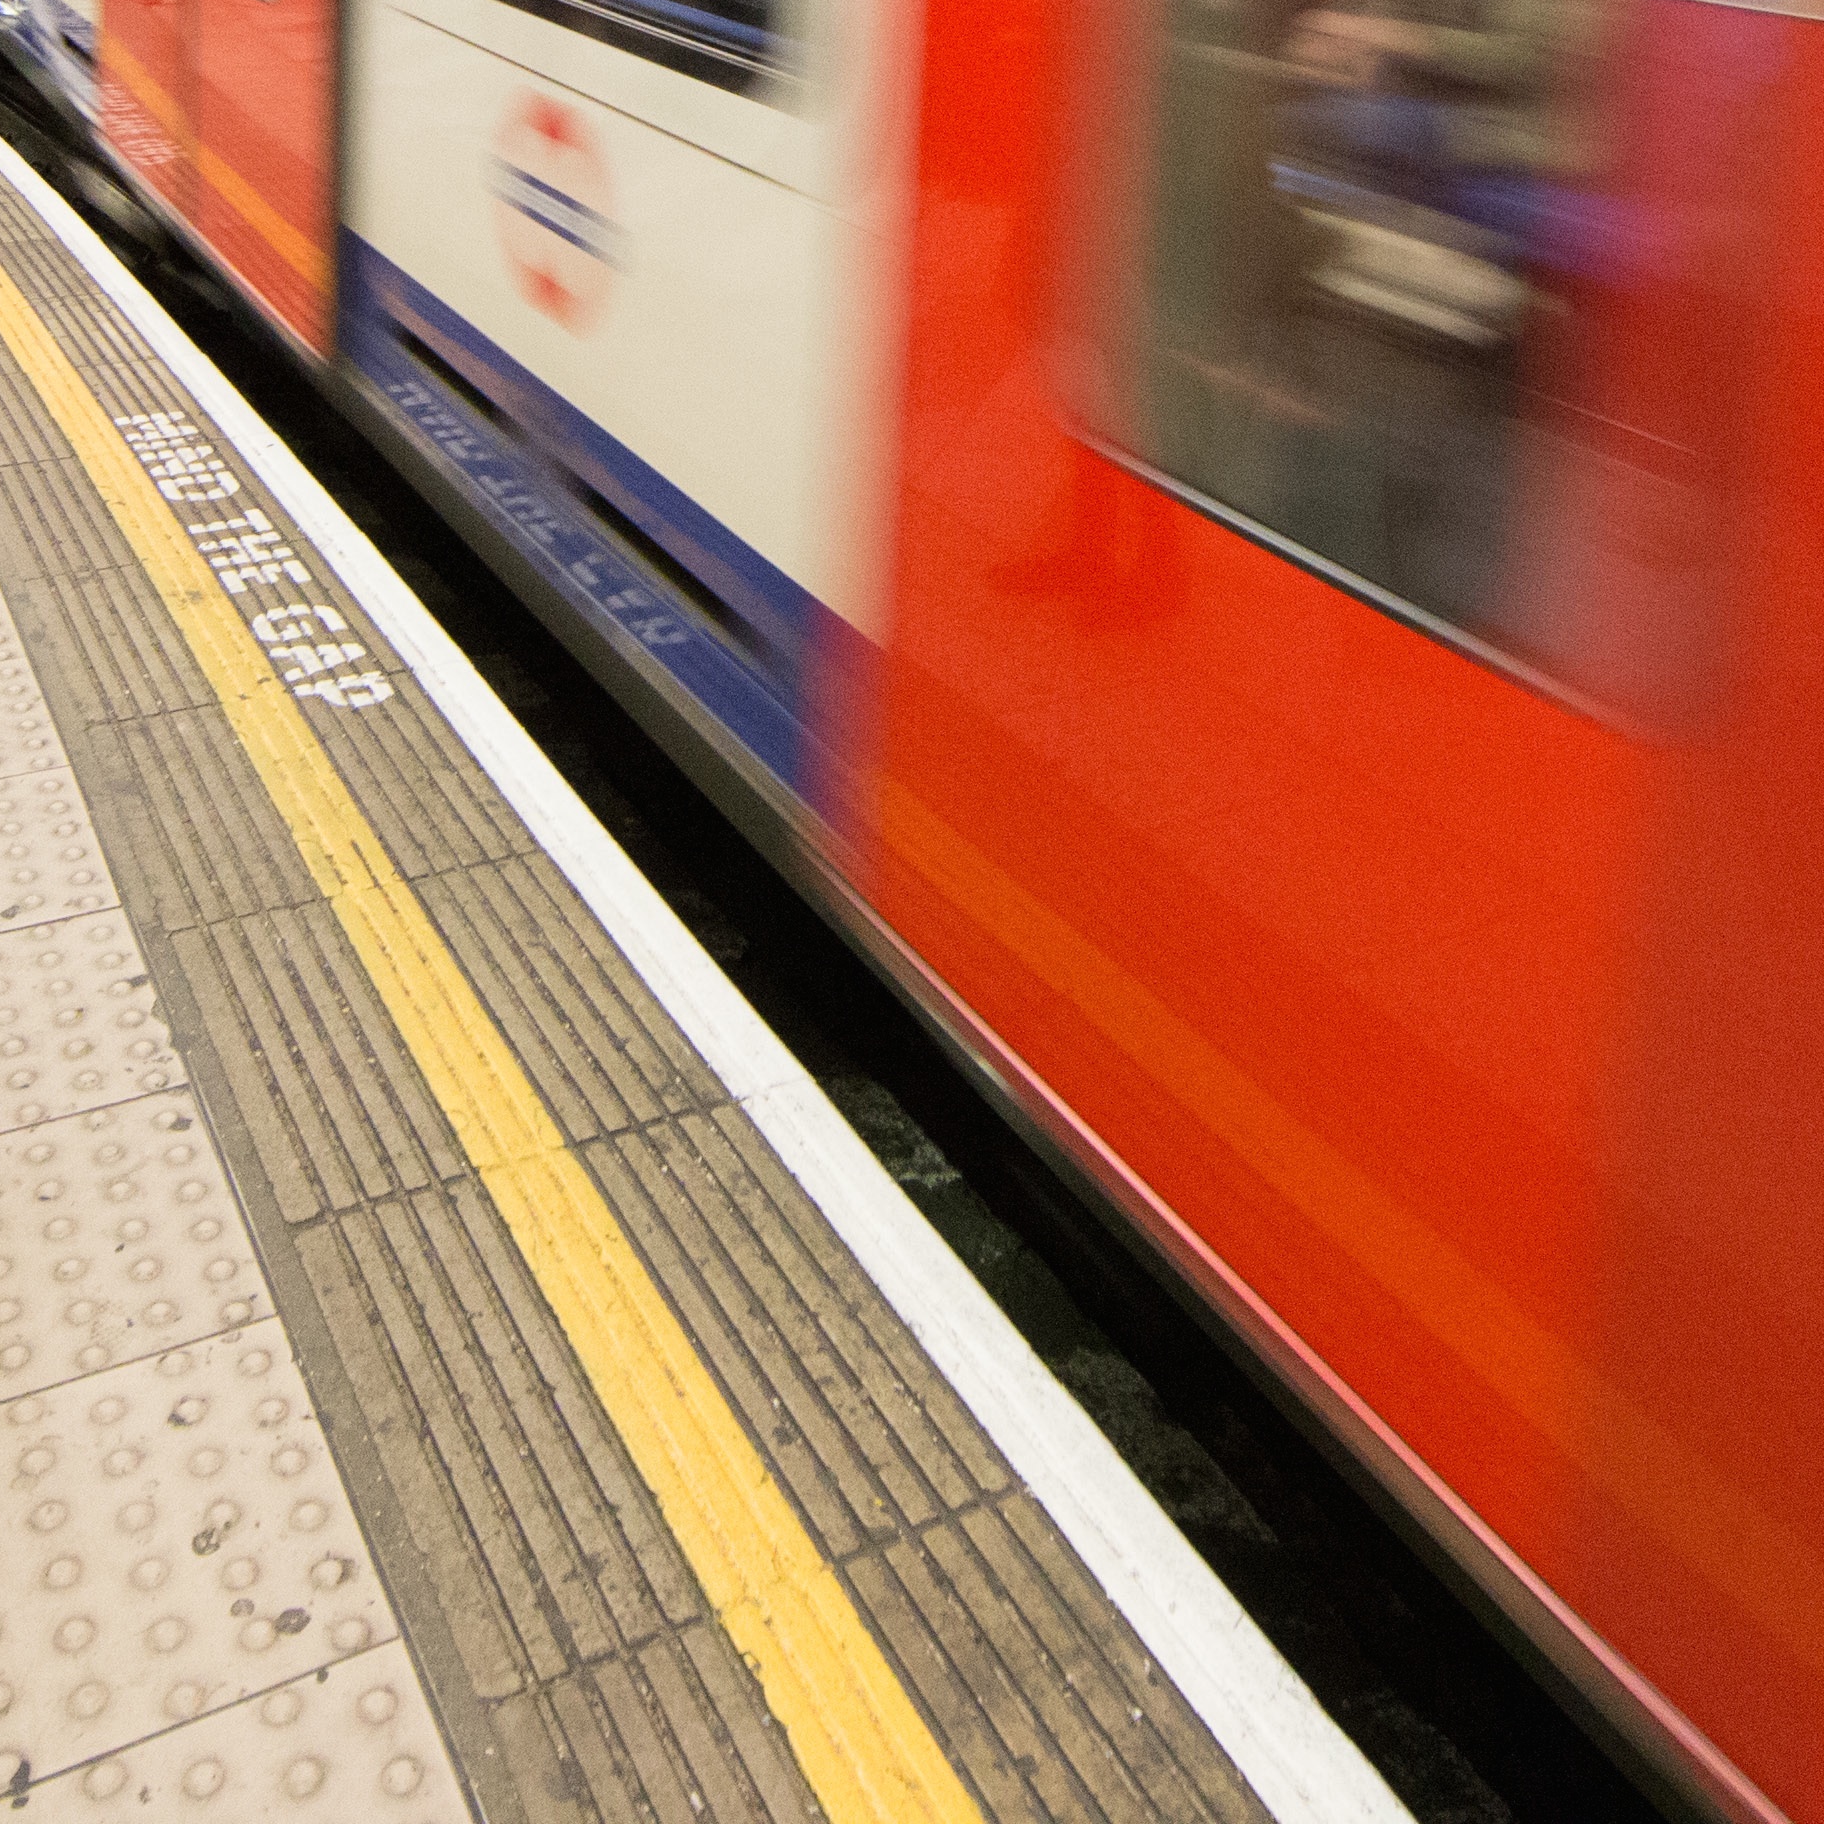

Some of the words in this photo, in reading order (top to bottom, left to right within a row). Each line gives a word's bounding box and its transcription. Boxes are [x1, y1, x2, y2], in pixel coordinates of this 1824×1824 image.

[113, 410, 241, 502] MIND
[188, 508, 312, 594] THE
[251, 604, 395, 709] GAP
